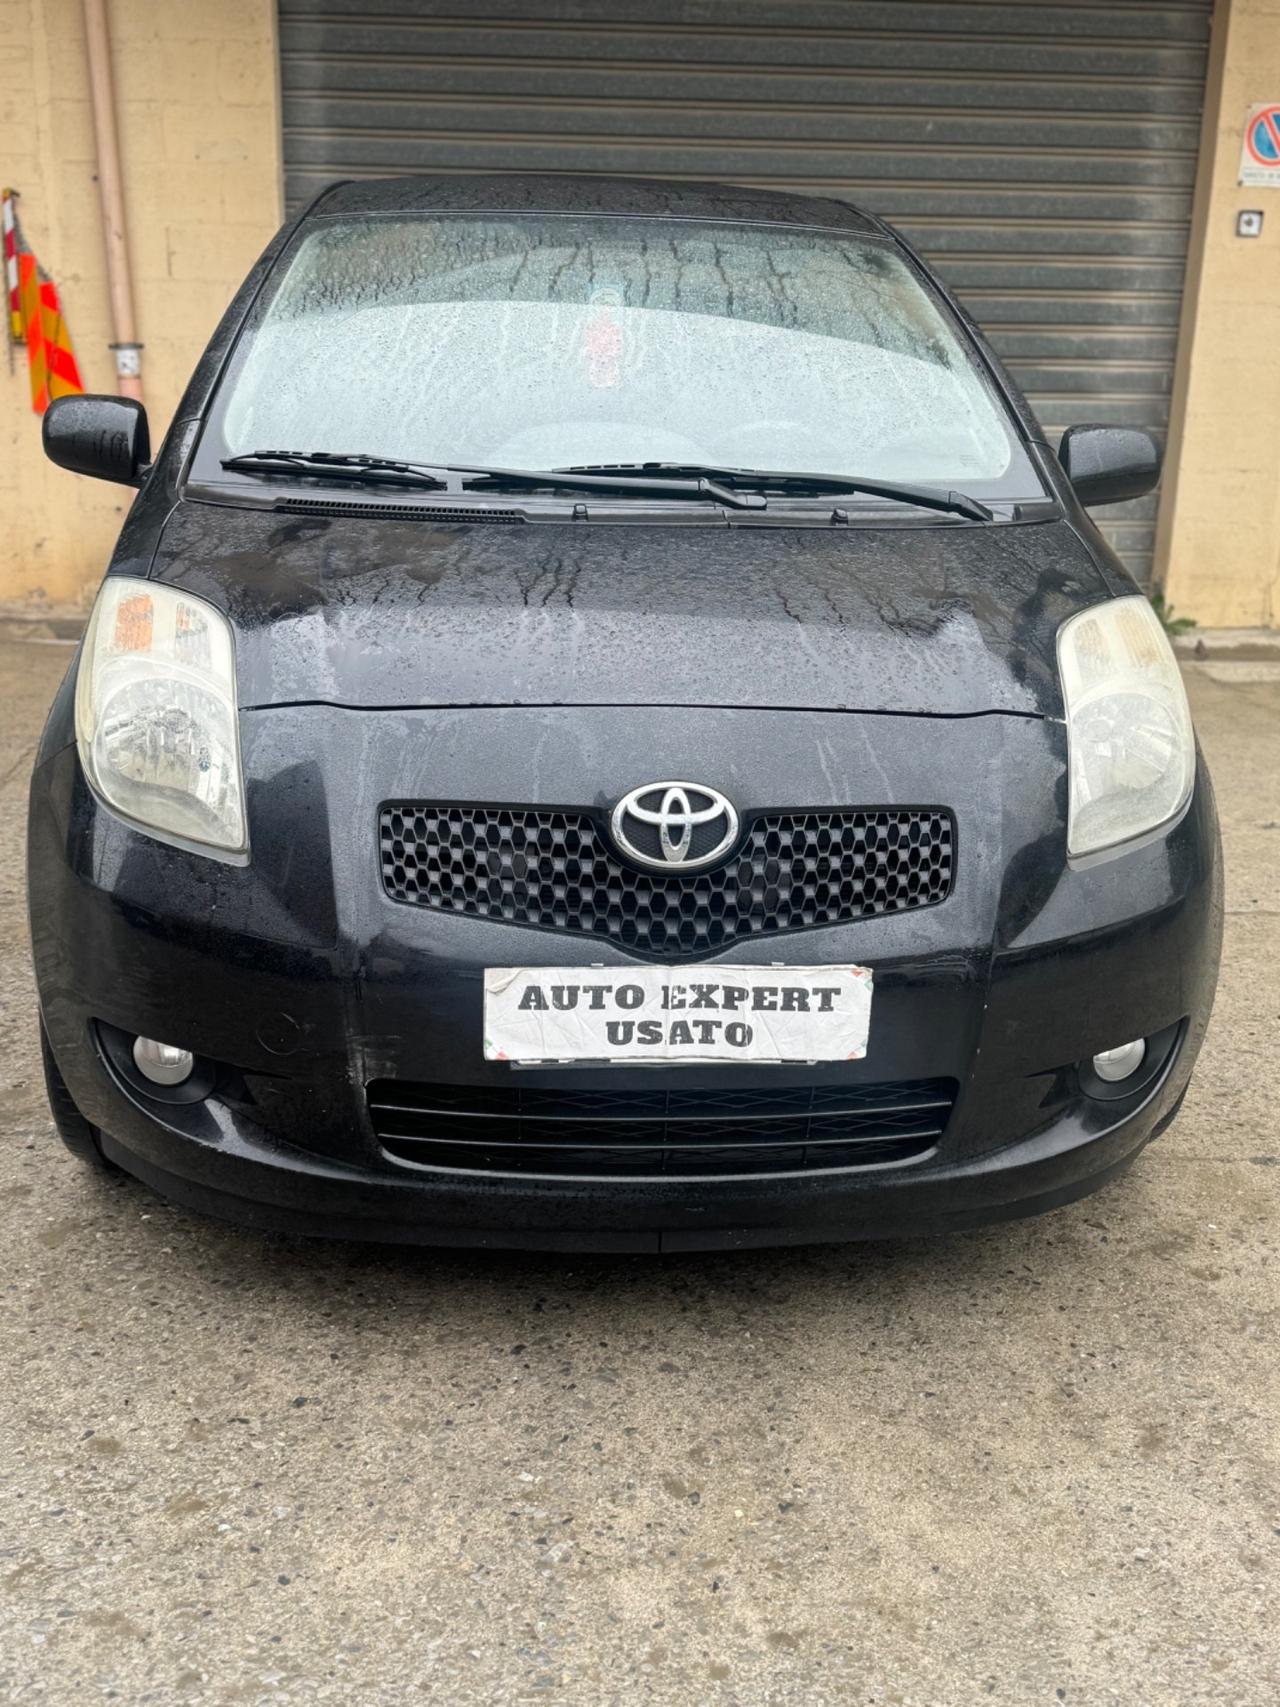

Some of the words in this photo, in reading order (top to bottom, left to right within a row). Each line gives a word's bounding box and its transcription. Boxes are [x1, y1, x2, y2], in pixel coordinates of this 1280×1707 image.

[517, 984, 645, 1010] AUTO
[661, 984, 842, 1012] EXPERT
[605, 1019, 753, 1048] USATO
